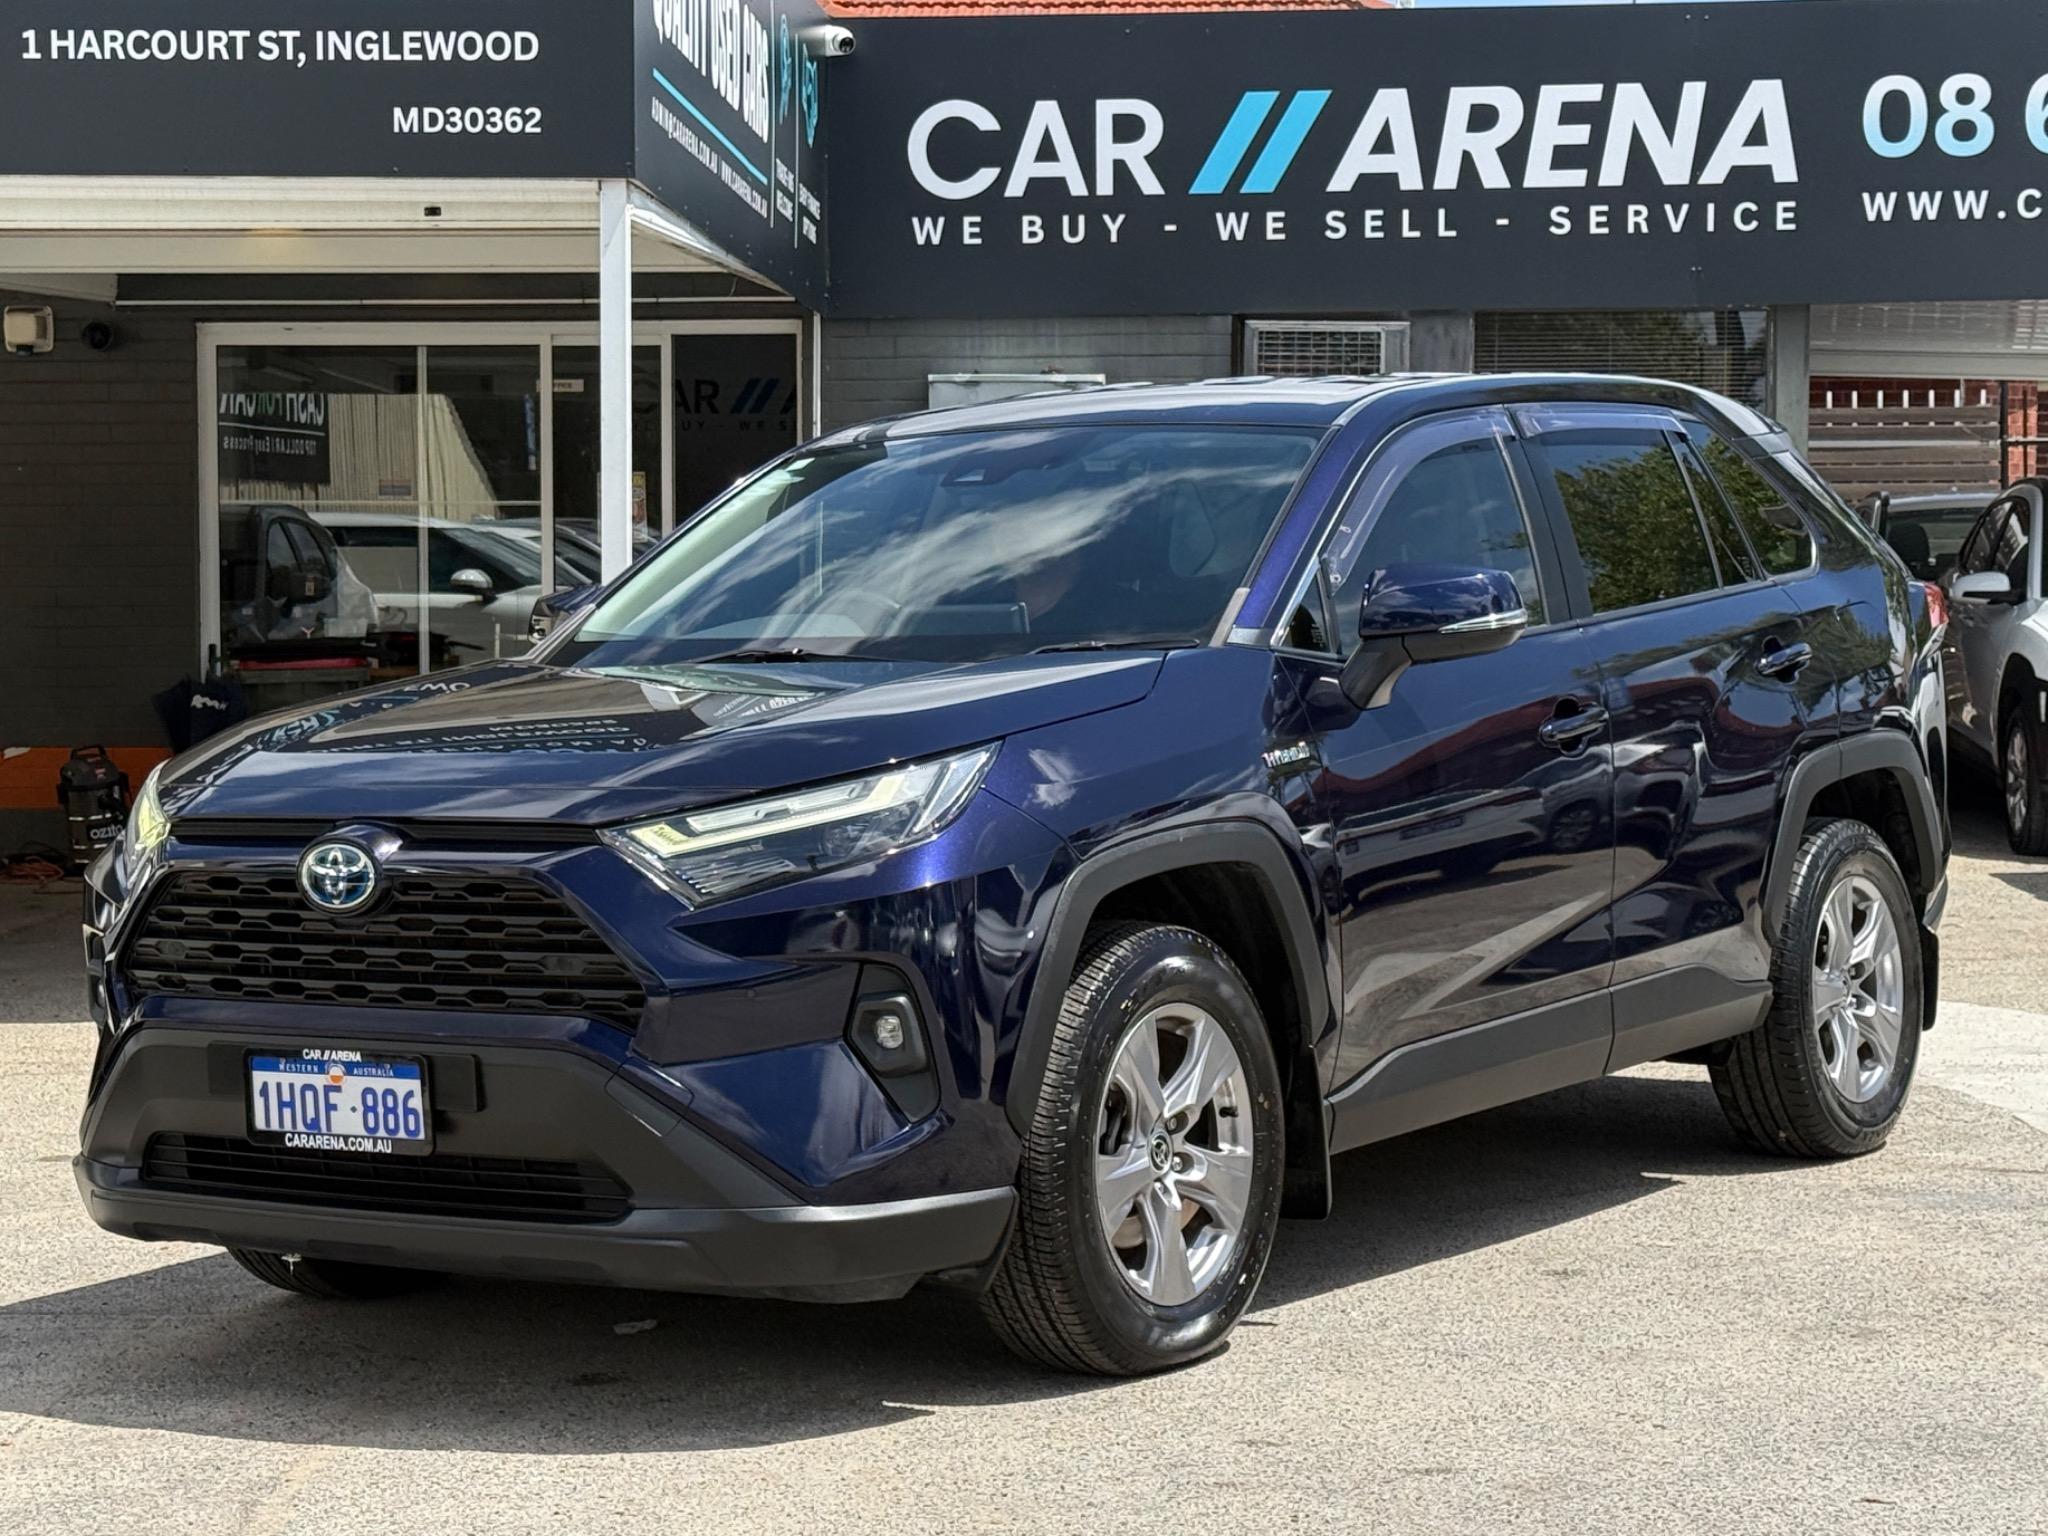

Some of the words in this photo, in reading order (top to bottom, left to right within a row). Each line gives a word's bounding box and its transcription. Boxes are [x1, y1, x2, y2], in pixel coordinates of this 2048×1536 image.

[22, 29, 41, 60] 1
[50, 28, 251, 61] HARCOURT
[257, 29, 307, 68] ST,
[315, 29, 539, 62] INGLEWOOD
[653, 0, 708, 78] LITY
[710, 0, 740, 112] USED
[743, 3, 769, 144] CARS
[392, 105, 543, 134] MD30362
[1862, 72, 1996, 159] 08
[907, 98, 1166, 200] CAR
[1324, 78, 1799, 193] ARENA
[911, 216, 983, 246] WE
[1020, 213, 1126, 244] BUY
[1215, 210, 1287, 242] WE
[1324, 206, 1458, 240] SELL
[1549, 201, 1798, 236] SERVICE
[279, 1063, 319, 1074] WESTERN
[353, 1066, 394, 1077] AUSTRALIA
[284, 1132, 393, 1154] CARARENA.COM.AU
